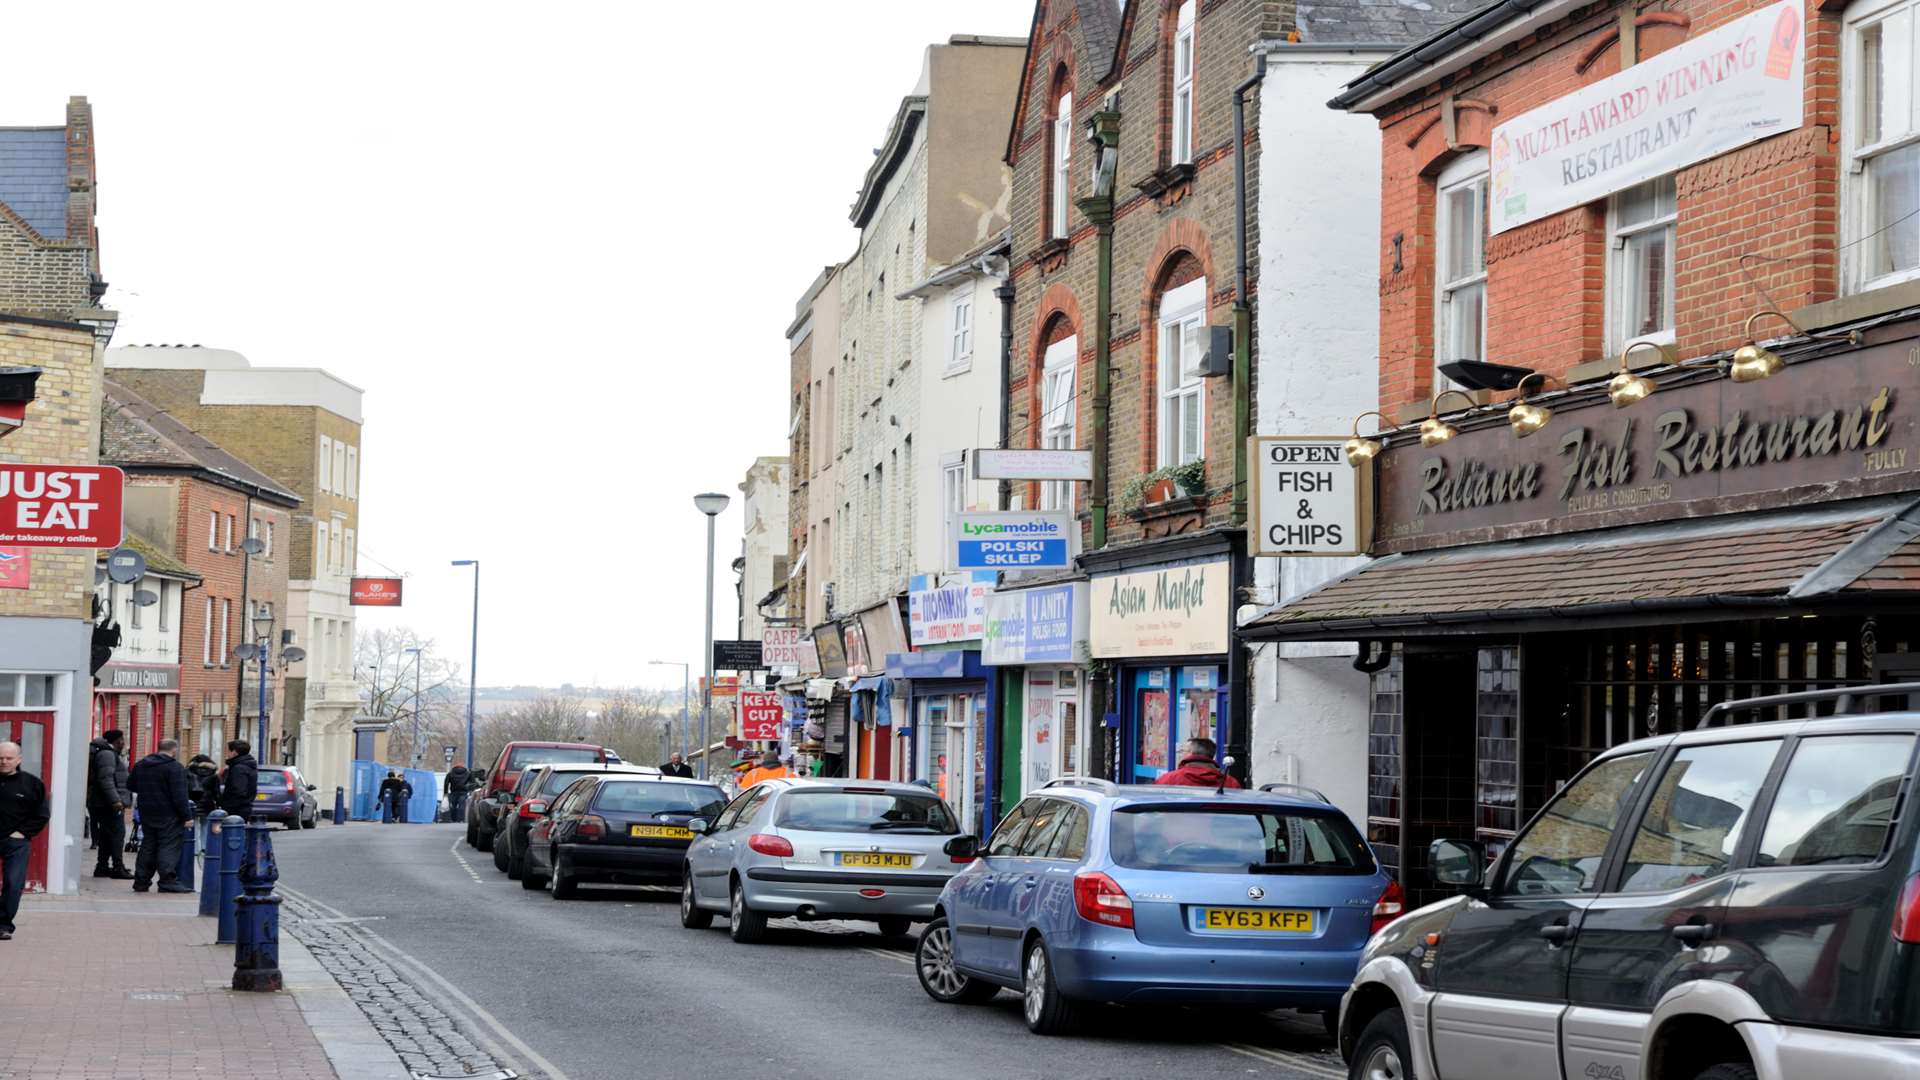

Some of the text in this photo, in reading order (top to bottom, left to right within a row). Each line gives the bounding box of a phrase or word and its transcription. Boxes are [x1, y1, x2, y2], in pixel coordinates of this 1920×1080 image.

[1654, 36, 1758, 104] WINNING
[1560, 107, 1697, 185] RESTAURANT
[1271, 446, 1341, 462] OPEN
[1416, 386, 1889, 514] Reliance Fish Restaurant
[1866, 448, 1906, 471] FULLY
[0, 470, 100, 499] JUST
[1279, 471, 1332, 492] FISH
[16, 501, 99, 530] EAT
[1297, 498, 1313, 519] &
[963, 521, 1058, 535] Lycamobile
[1269, 524, 1342, 545] CHIPS
[16, 534, 65, 543] takeaway
[67, 535, 98, 543] online
[981, 541, 1044, 552] POLSKI
[985, 553, 1041, 564] SKLEP
[1109, 567, 1204, 619] Asian Market
[764, 630, 799, 645] CAFE
[1051, 622, 1067, 638] FOOD
[764, 648, 799, 663] OPEN
[743, 695, 781, 706] KEYS
[748, 709, 778, 720] CUT
[636, 826, 690, 837] N914 CMM
[843, 854, 911, 866] GF03 MJU
[1210, 909, 1309, 928] EY63 KFP
